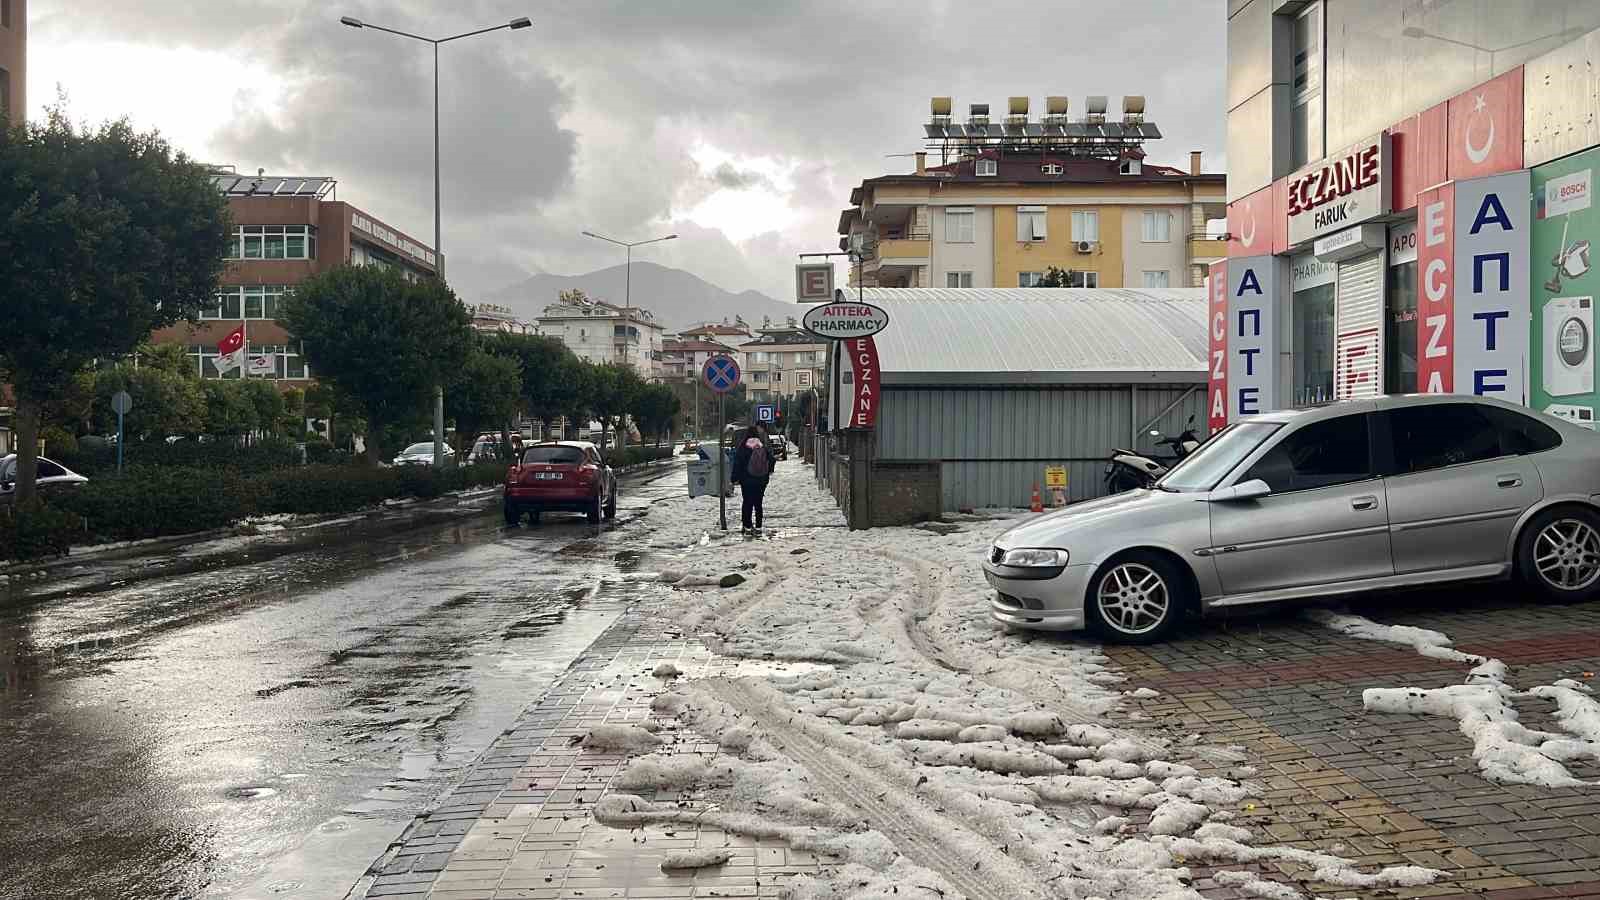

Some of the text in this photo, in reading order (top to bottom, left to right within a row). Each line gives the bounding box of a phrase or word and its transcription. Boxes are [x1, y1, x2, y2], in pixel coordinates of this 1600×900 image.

[1287, 145, 1378, 216] ECZANE
[1560, 181, 1586, 197] BOSCH
[1314, 201, 1348, 229] FARUK
[806, 272, 825, 294] E
[823, 306, 873, 317] АПТЕКА
[812, 319, 883, 332] PHARMACY
[1211, 271, 1226, 430] ECZA
[856, 339, 871, 425] ECZANE
[761, 409, 769, 419] D
